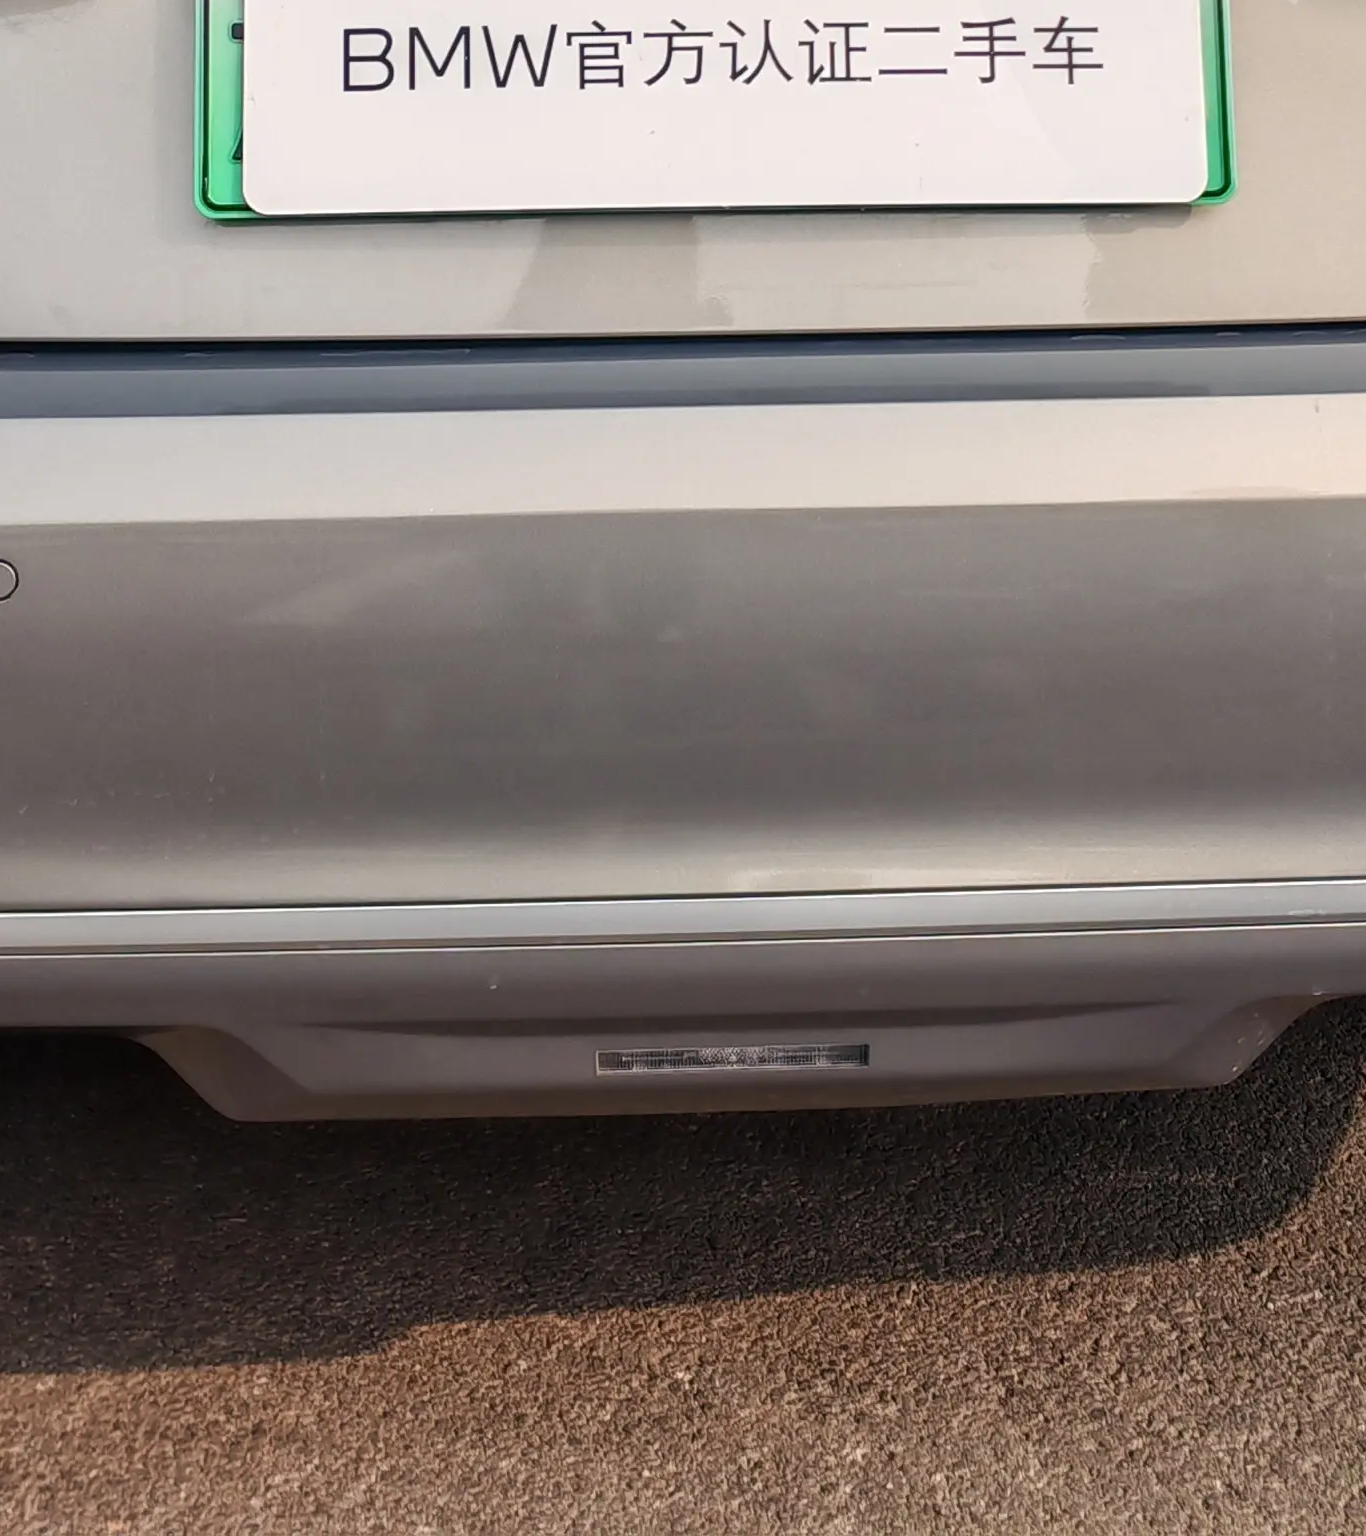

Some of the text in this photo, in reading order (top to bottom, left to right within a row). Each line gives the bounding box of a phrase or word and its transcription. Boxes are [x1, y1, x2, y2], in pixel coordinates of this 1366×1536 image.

[343, 15, 1104, 92] BMW官方认证二手车
